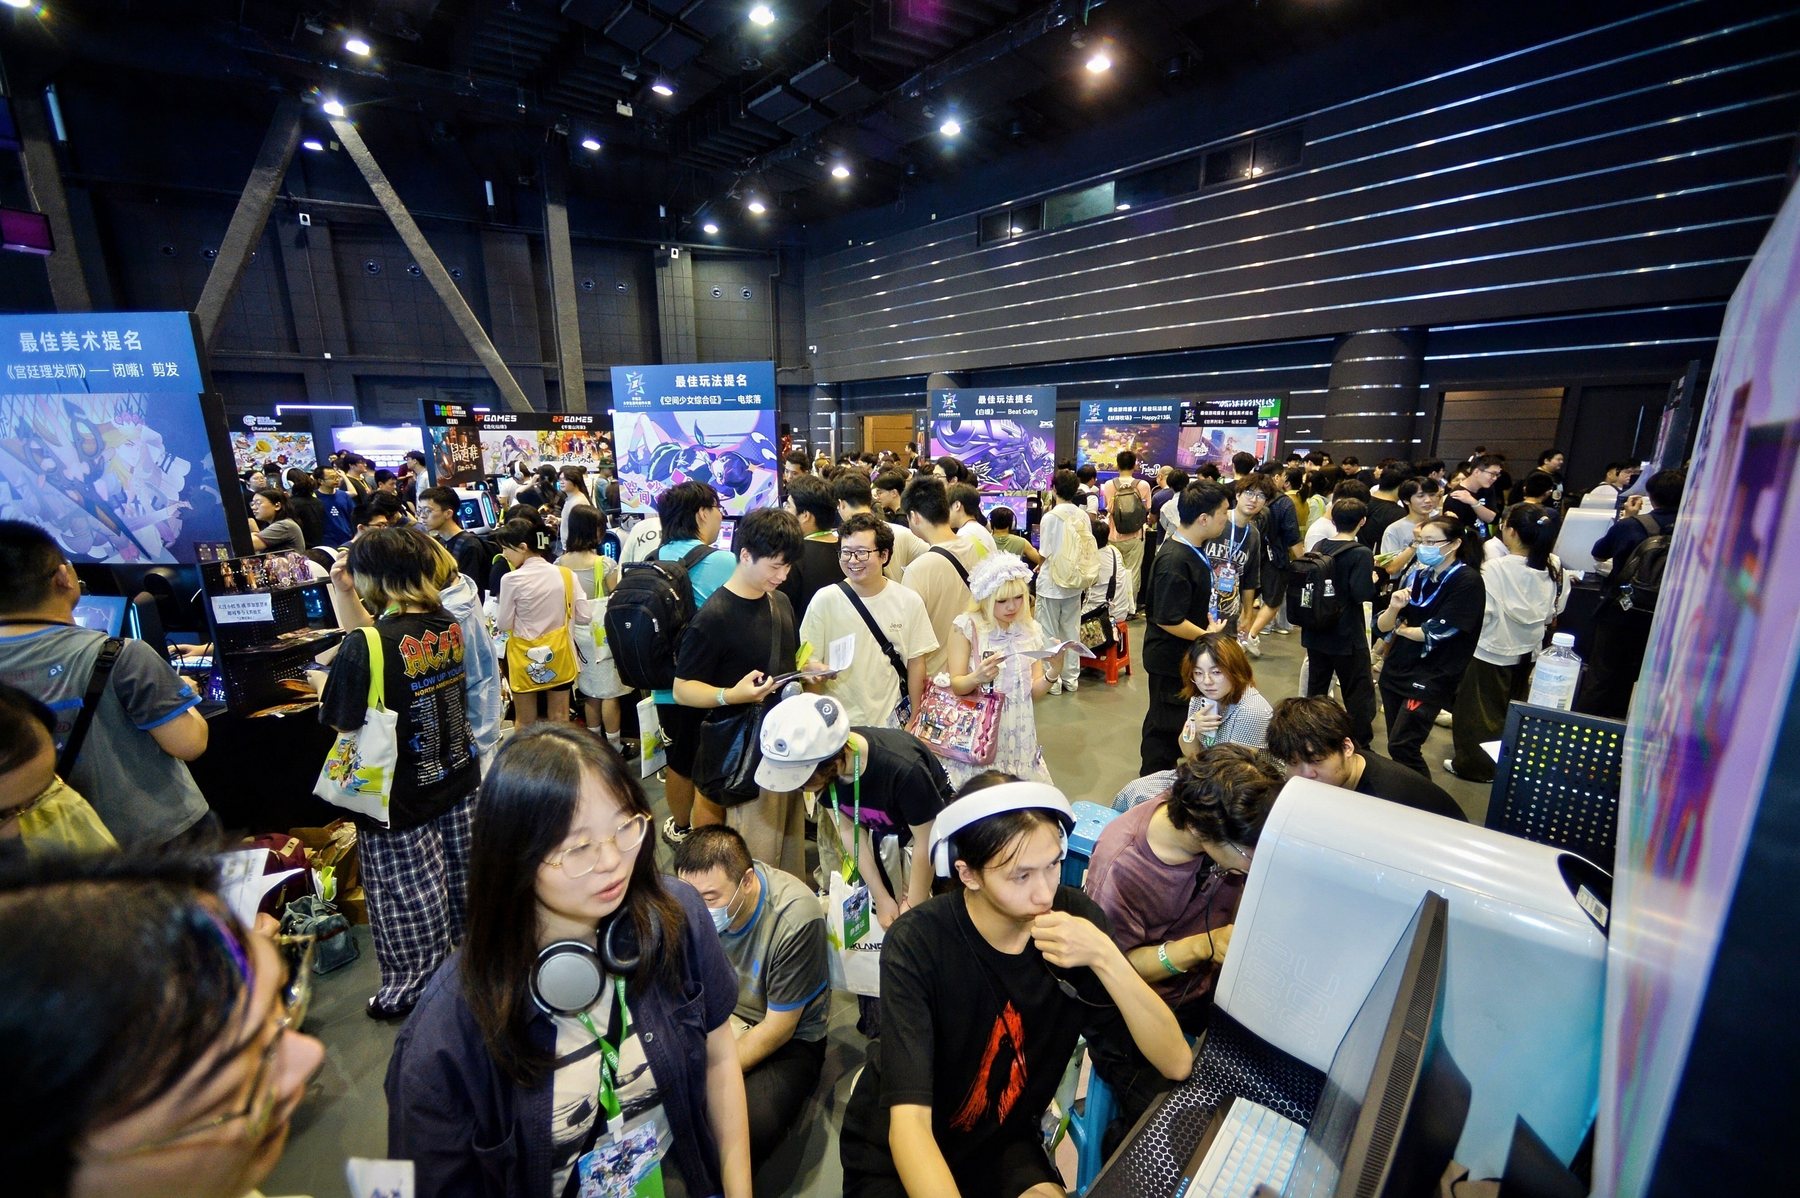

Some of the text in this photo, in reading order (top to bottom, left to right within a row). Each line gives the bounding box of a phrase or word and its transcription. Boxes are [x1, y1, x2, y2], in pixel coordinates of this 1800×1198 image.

[20, 330, 143, 353] 最佳美术提名
[675, 373, 748, 388] 最佳玩法提名
[978, 394, 1033, 404] 最佳玩法提名
[1022, 408, 1038, 416] Gang
[410, 676, 437, 692] BLOW
[436, 672, 447, 682] UP
[414, 685, 436, 697] NORTH
